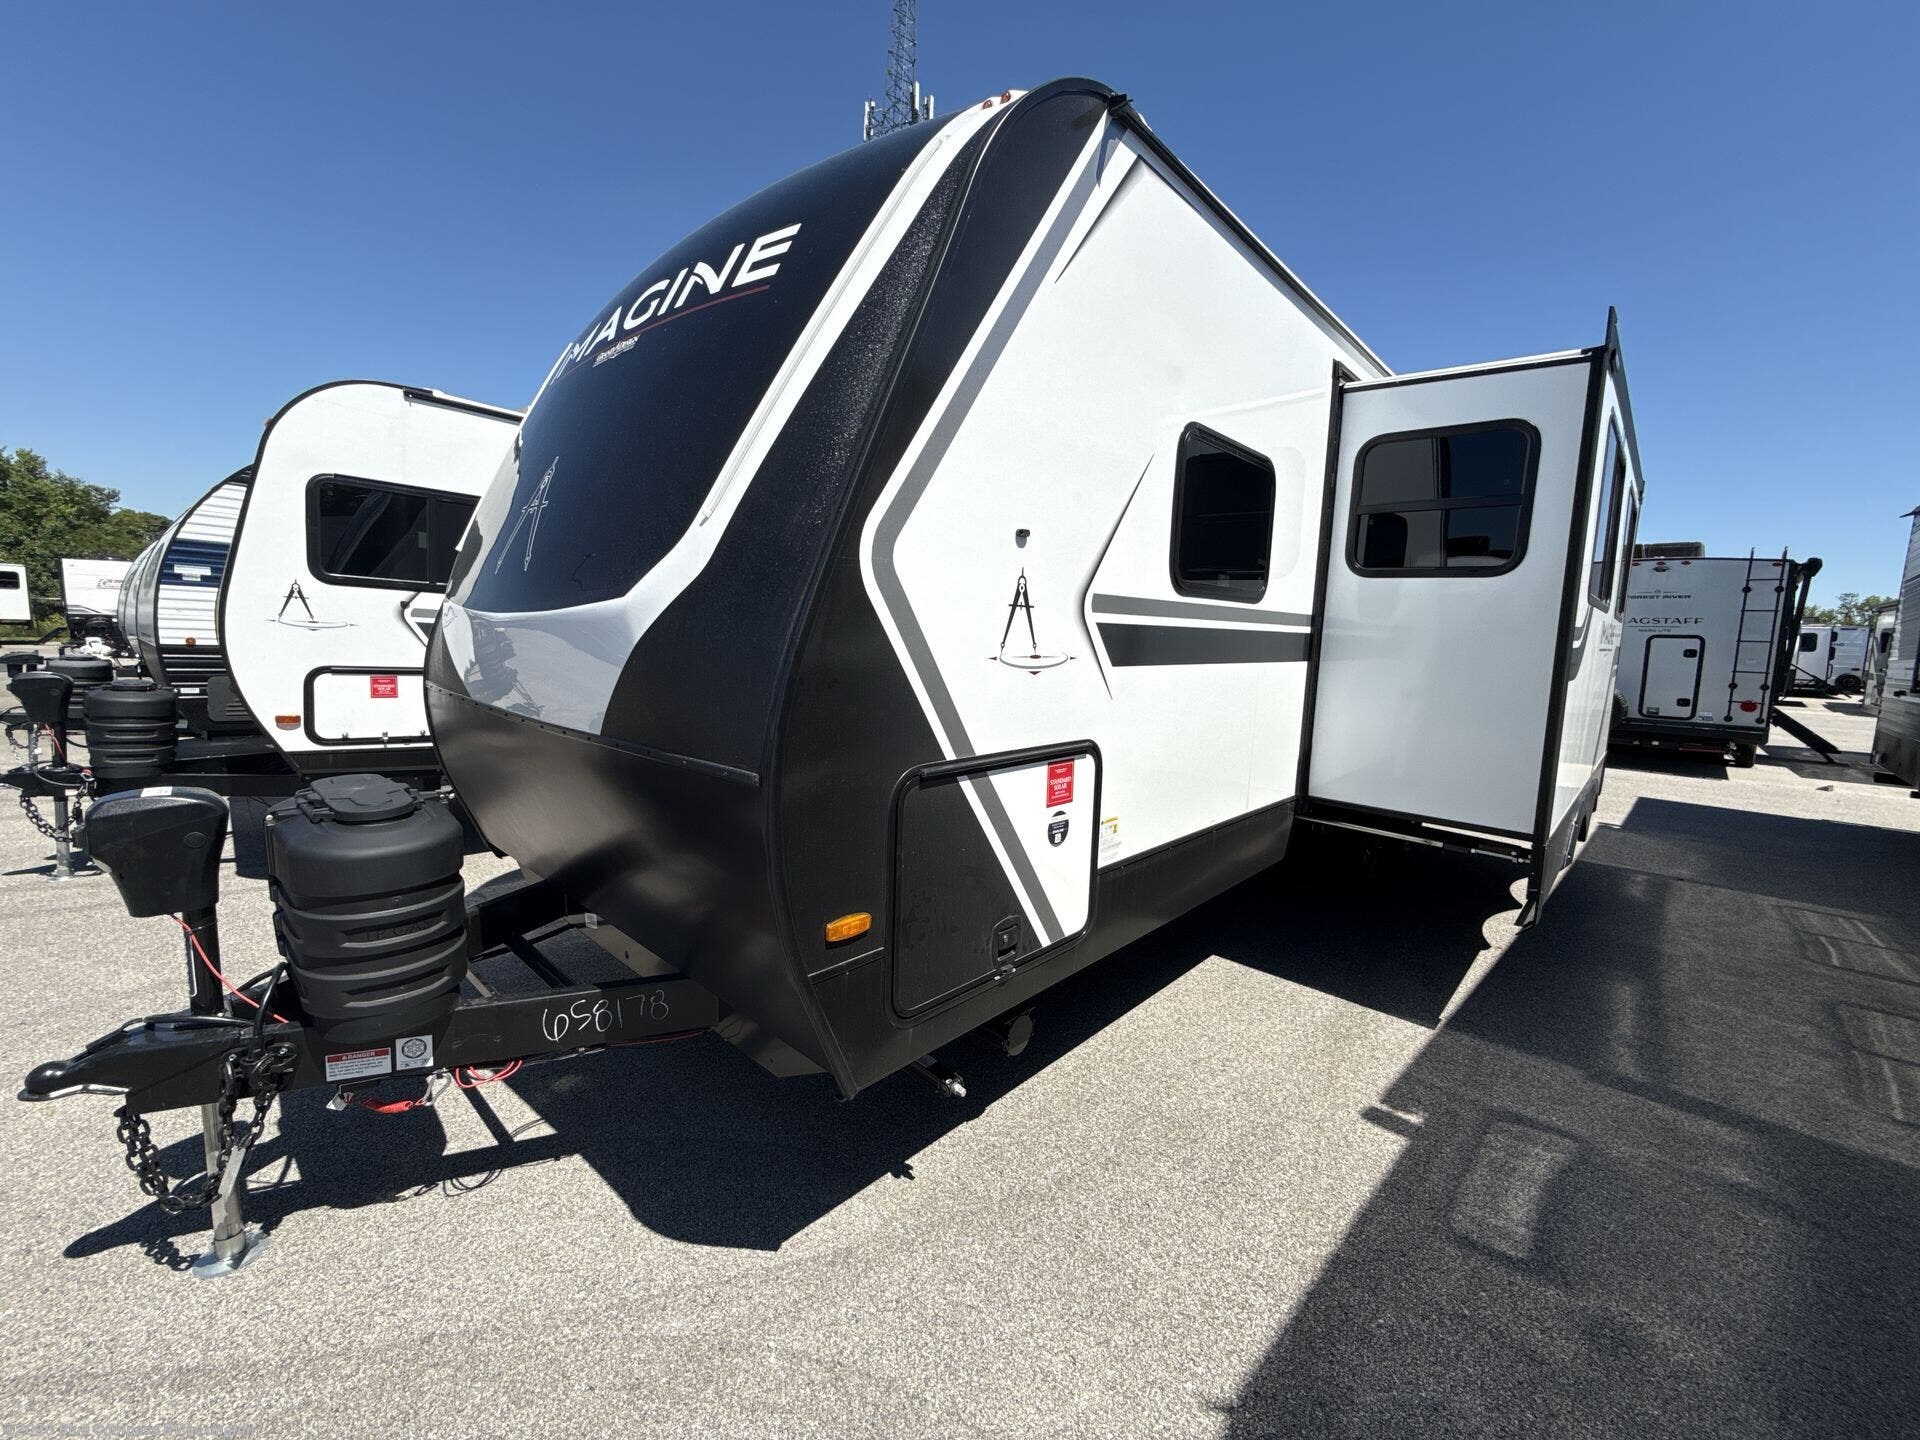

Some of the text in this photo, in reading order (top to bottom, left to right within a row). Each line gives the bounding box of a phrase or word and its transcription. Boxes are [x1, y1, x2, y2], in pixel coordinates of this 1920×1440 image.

[550, 222, 802, 386] IMAGINE
[1623, 617, 1704, 625] AGSTAFF
[542, 989, 669, 1041] 658178
[347, 1050, 376, 1060] DANGER
